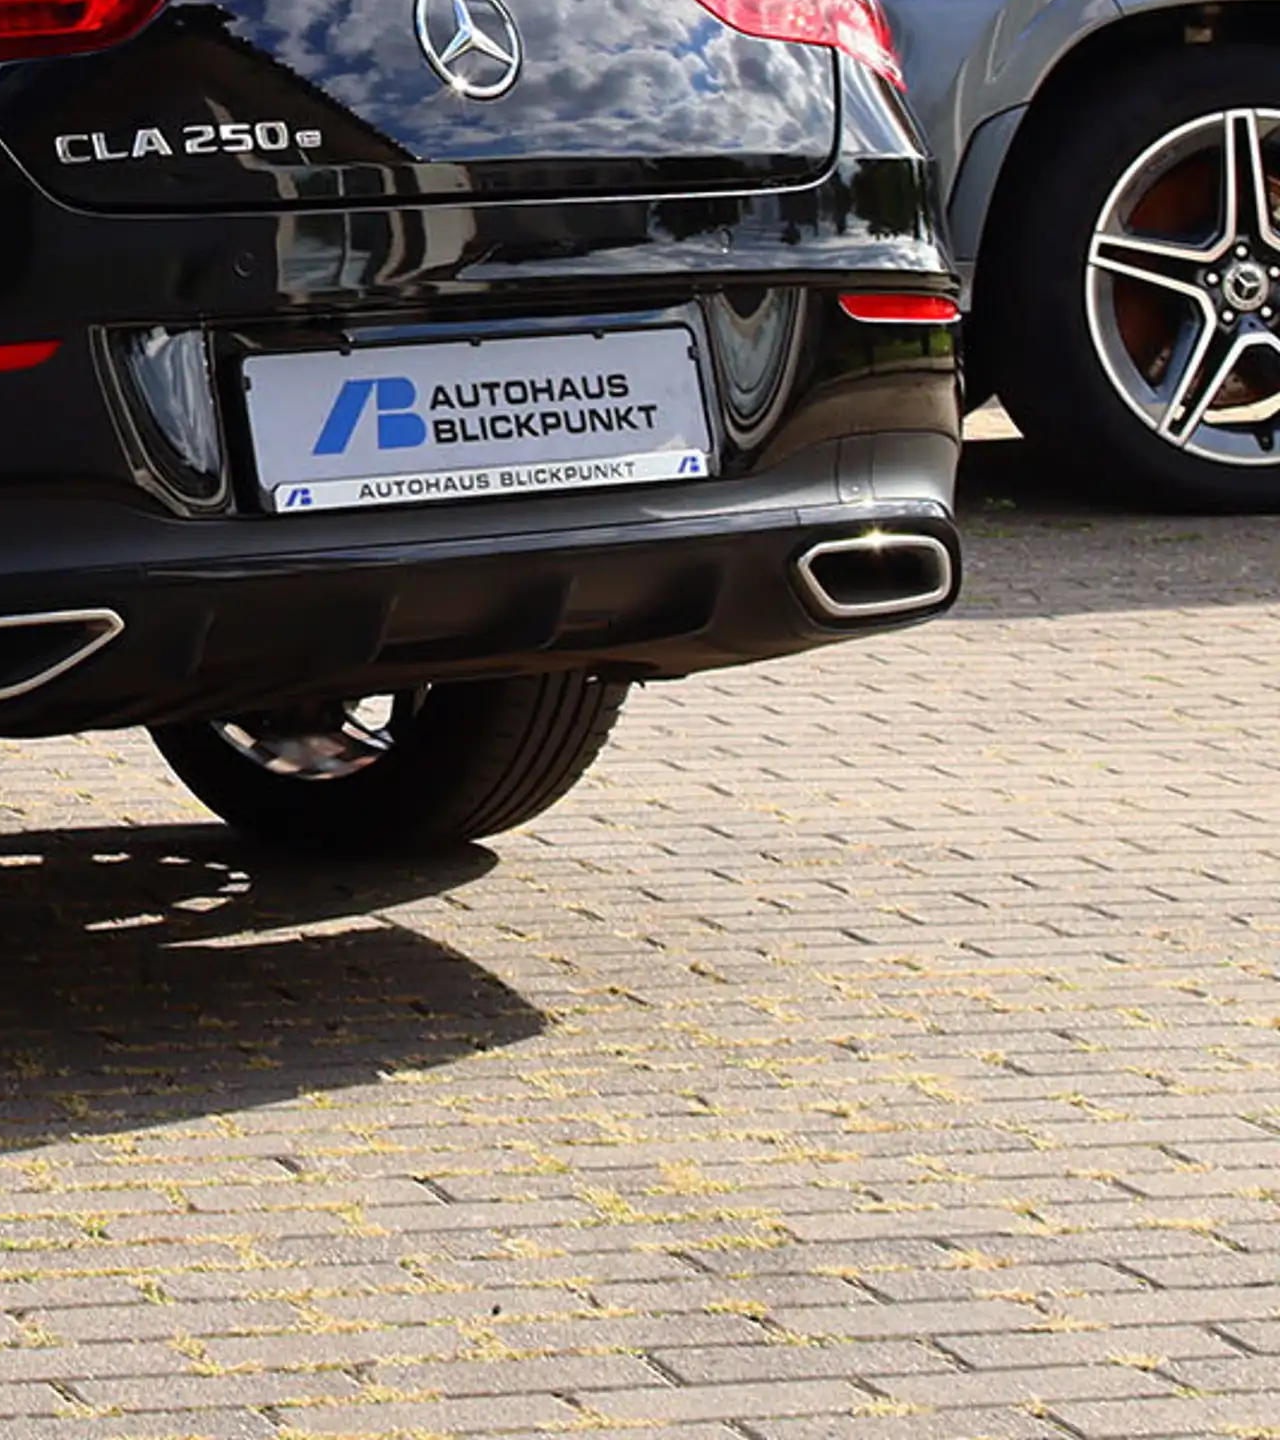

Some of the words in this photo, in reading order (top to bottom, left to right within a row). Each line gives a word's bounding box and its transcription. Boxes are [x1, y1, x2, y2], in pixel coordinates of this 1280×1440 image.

[54, 127, 174, 164] CLA
[430, 373, 630, 410] AUTOHAUS
[432, 404, 658, 444] BLICKPUNKT
[358, 472, 490, 500] AUTOHAUS
[499, 461, 636, 487] BLICKPUNKT
